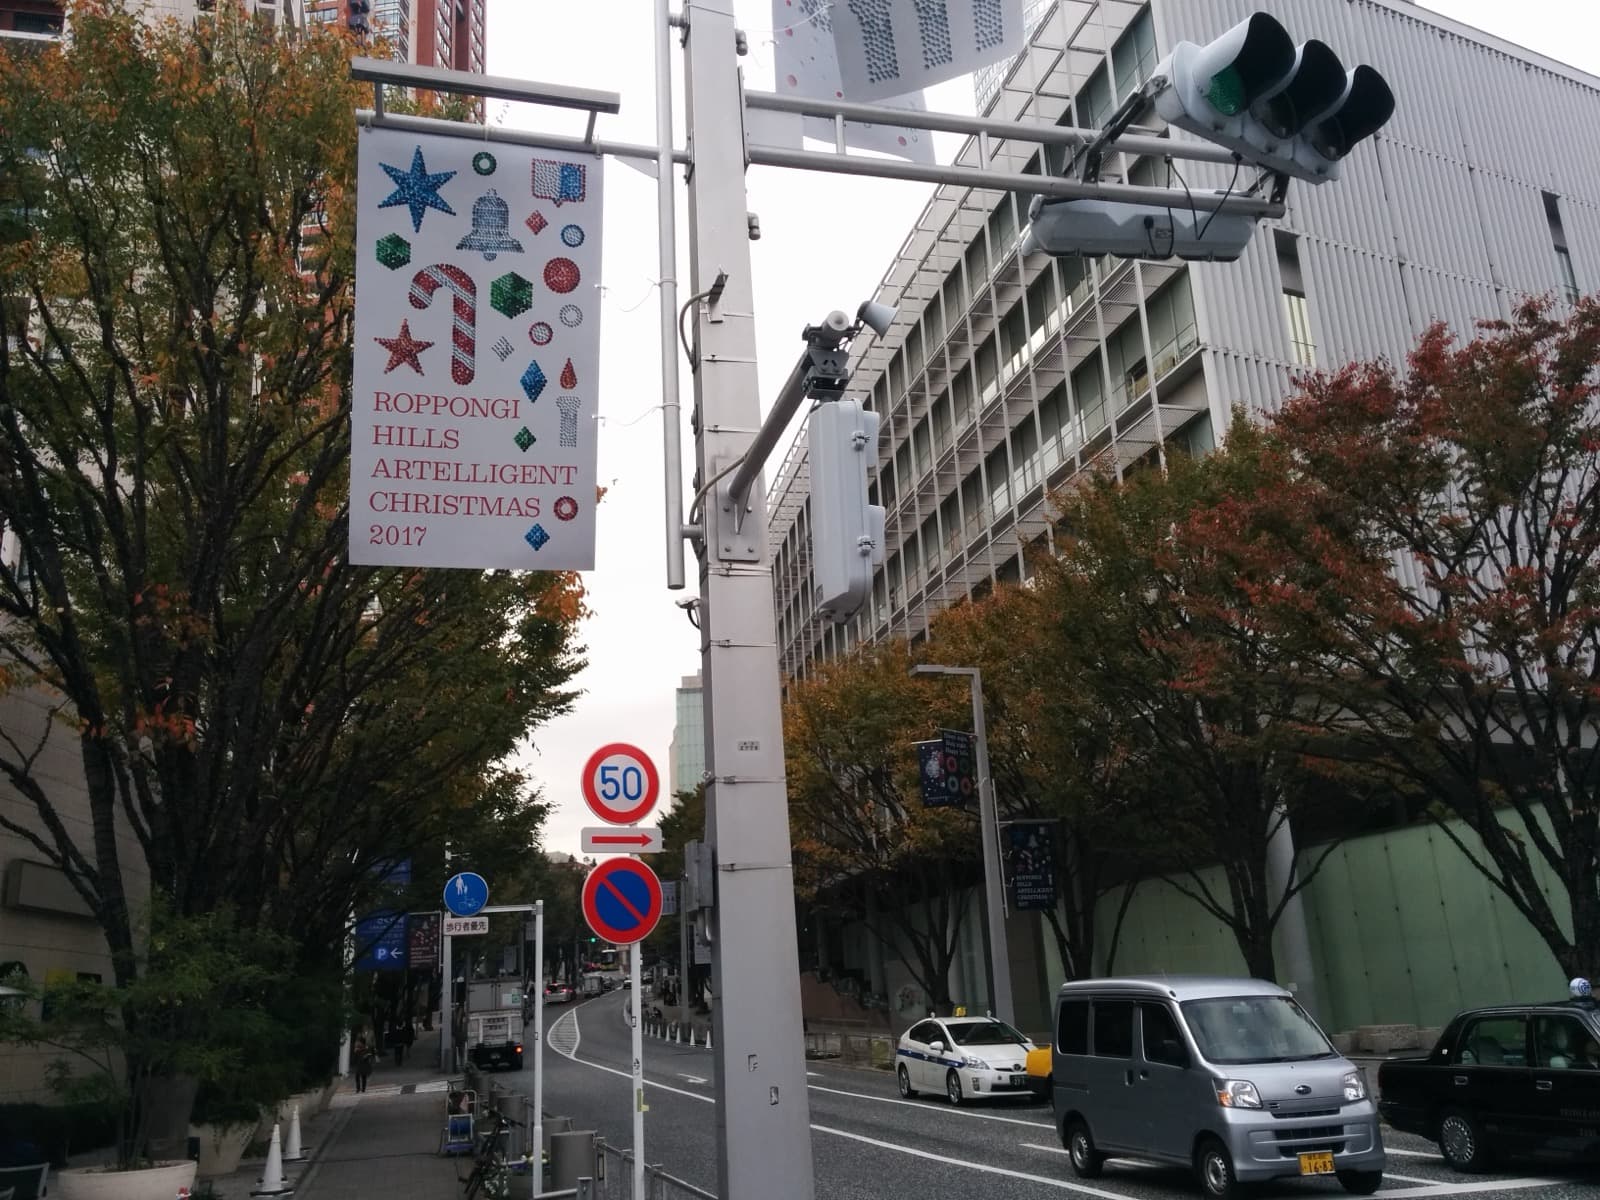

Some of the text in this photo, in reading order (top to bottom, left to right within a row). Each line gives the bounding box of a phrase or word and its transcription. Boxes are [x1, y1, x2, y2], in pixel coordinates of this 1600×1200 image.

[374, 391, 520, 419] ROPPONGI
[372, 425, 459, 449] HILLS
[371, 459, 578, 486] ARTELLIGENT
[369, 492, 540, 517] CHRISTMAS
[370, 525, 428, 546] 2017
[600, 766, 642, 801] 50
[446, 921, 487, 933] 歩行者優先
[377, 948, 387, 960] P
